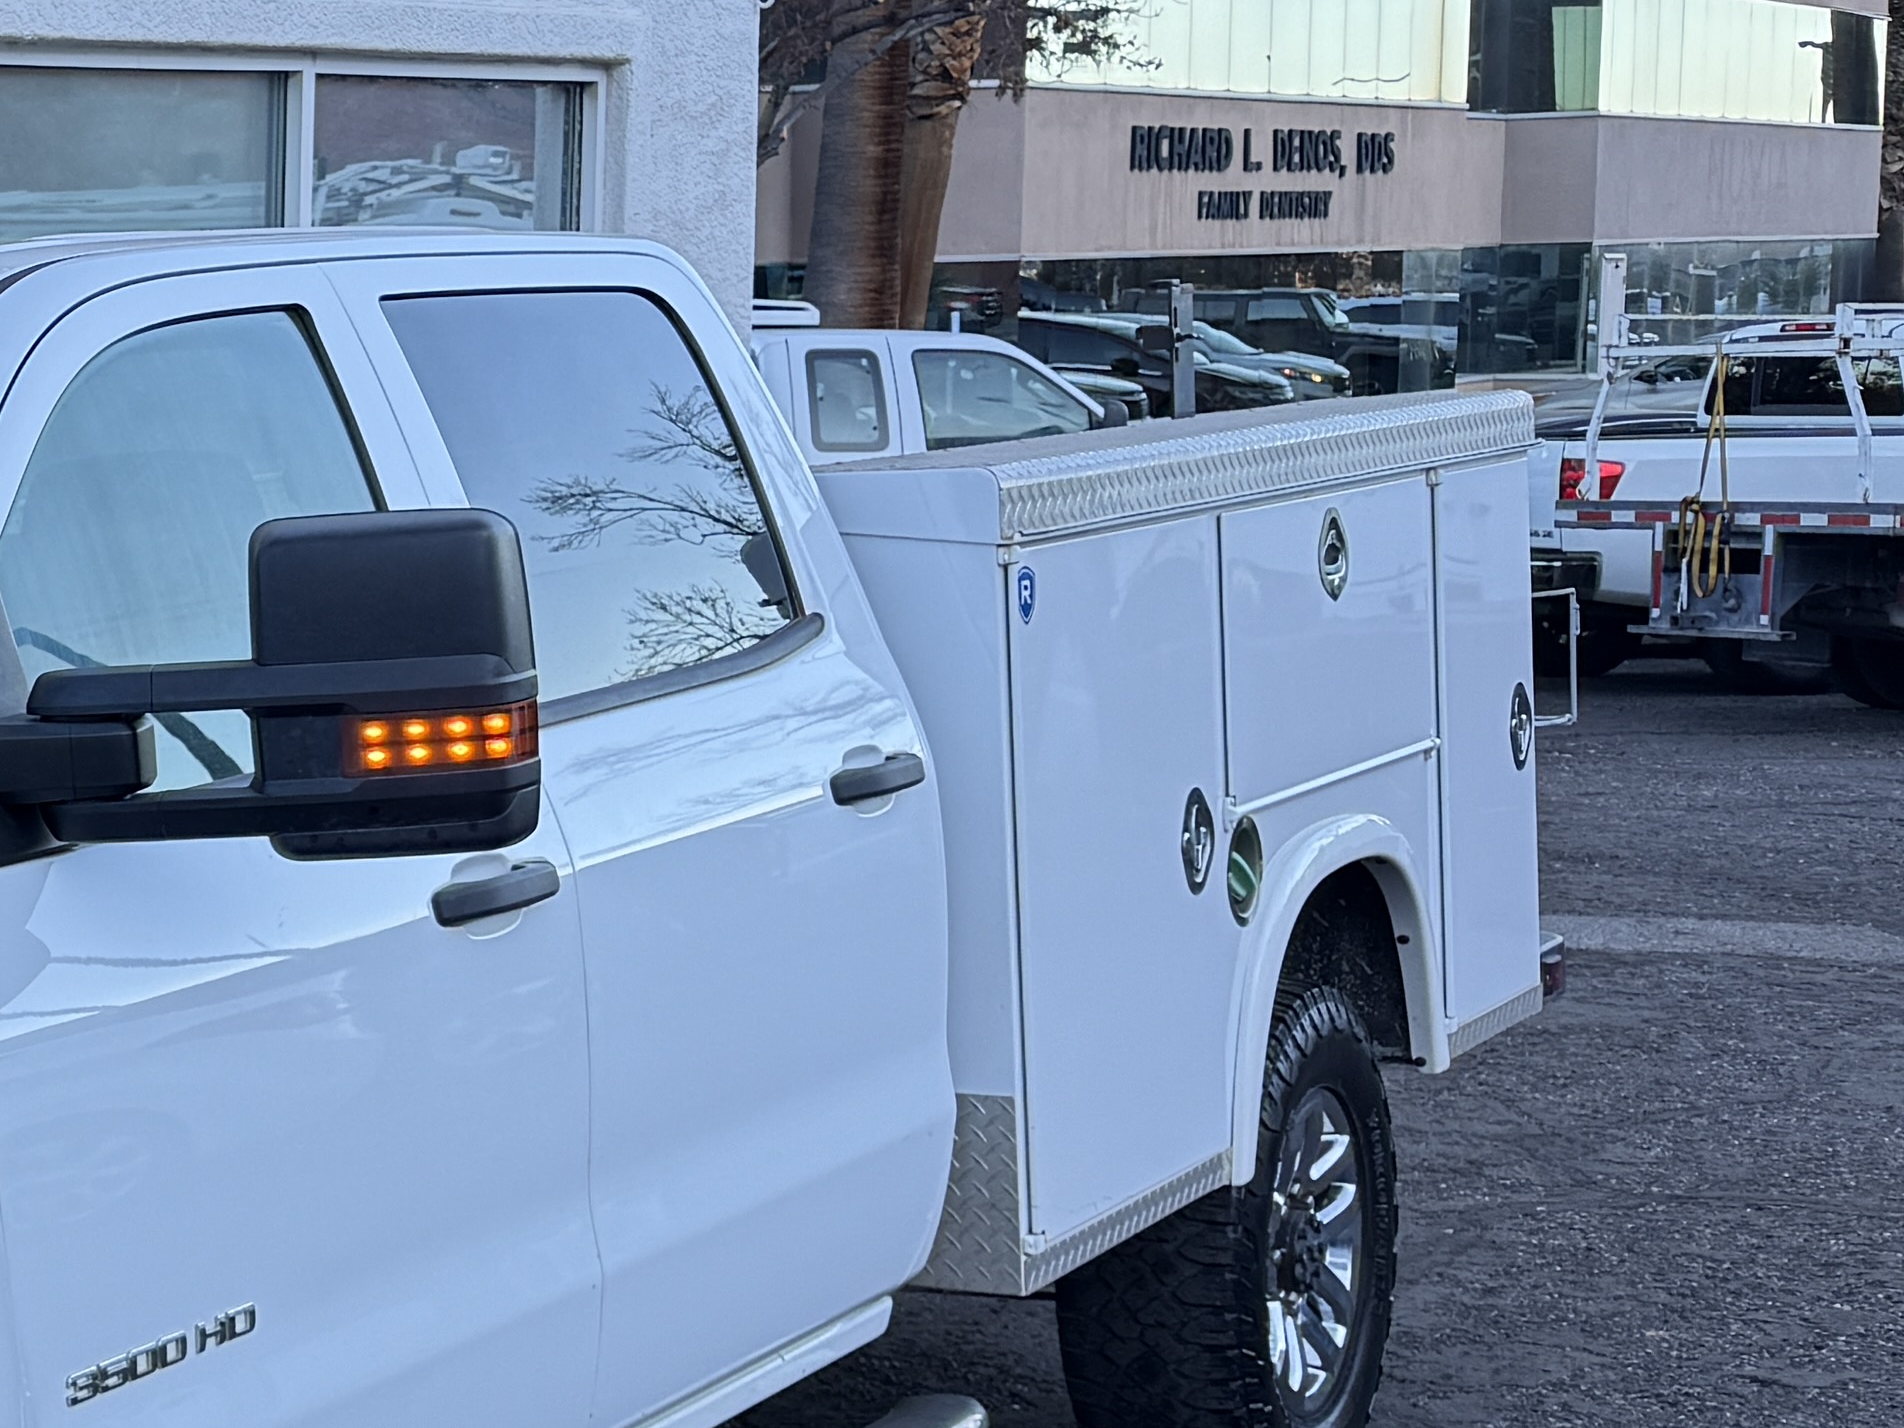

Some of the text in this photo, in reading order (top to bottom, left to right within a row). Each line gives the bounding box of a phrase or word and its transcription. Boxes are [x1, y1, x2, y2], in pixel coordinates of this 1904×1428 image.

[1129, 124, 1234, 173] RICHARD
[1242, 127, 1263, 173] L.
[1355, 131, 1396, 175] DDS
[1196, 189, 1334, 221] FAMILY DENTISTRY
[1020, 579, 1032, 605] R
[65, 1300, 257, 1408] 3500 HD
